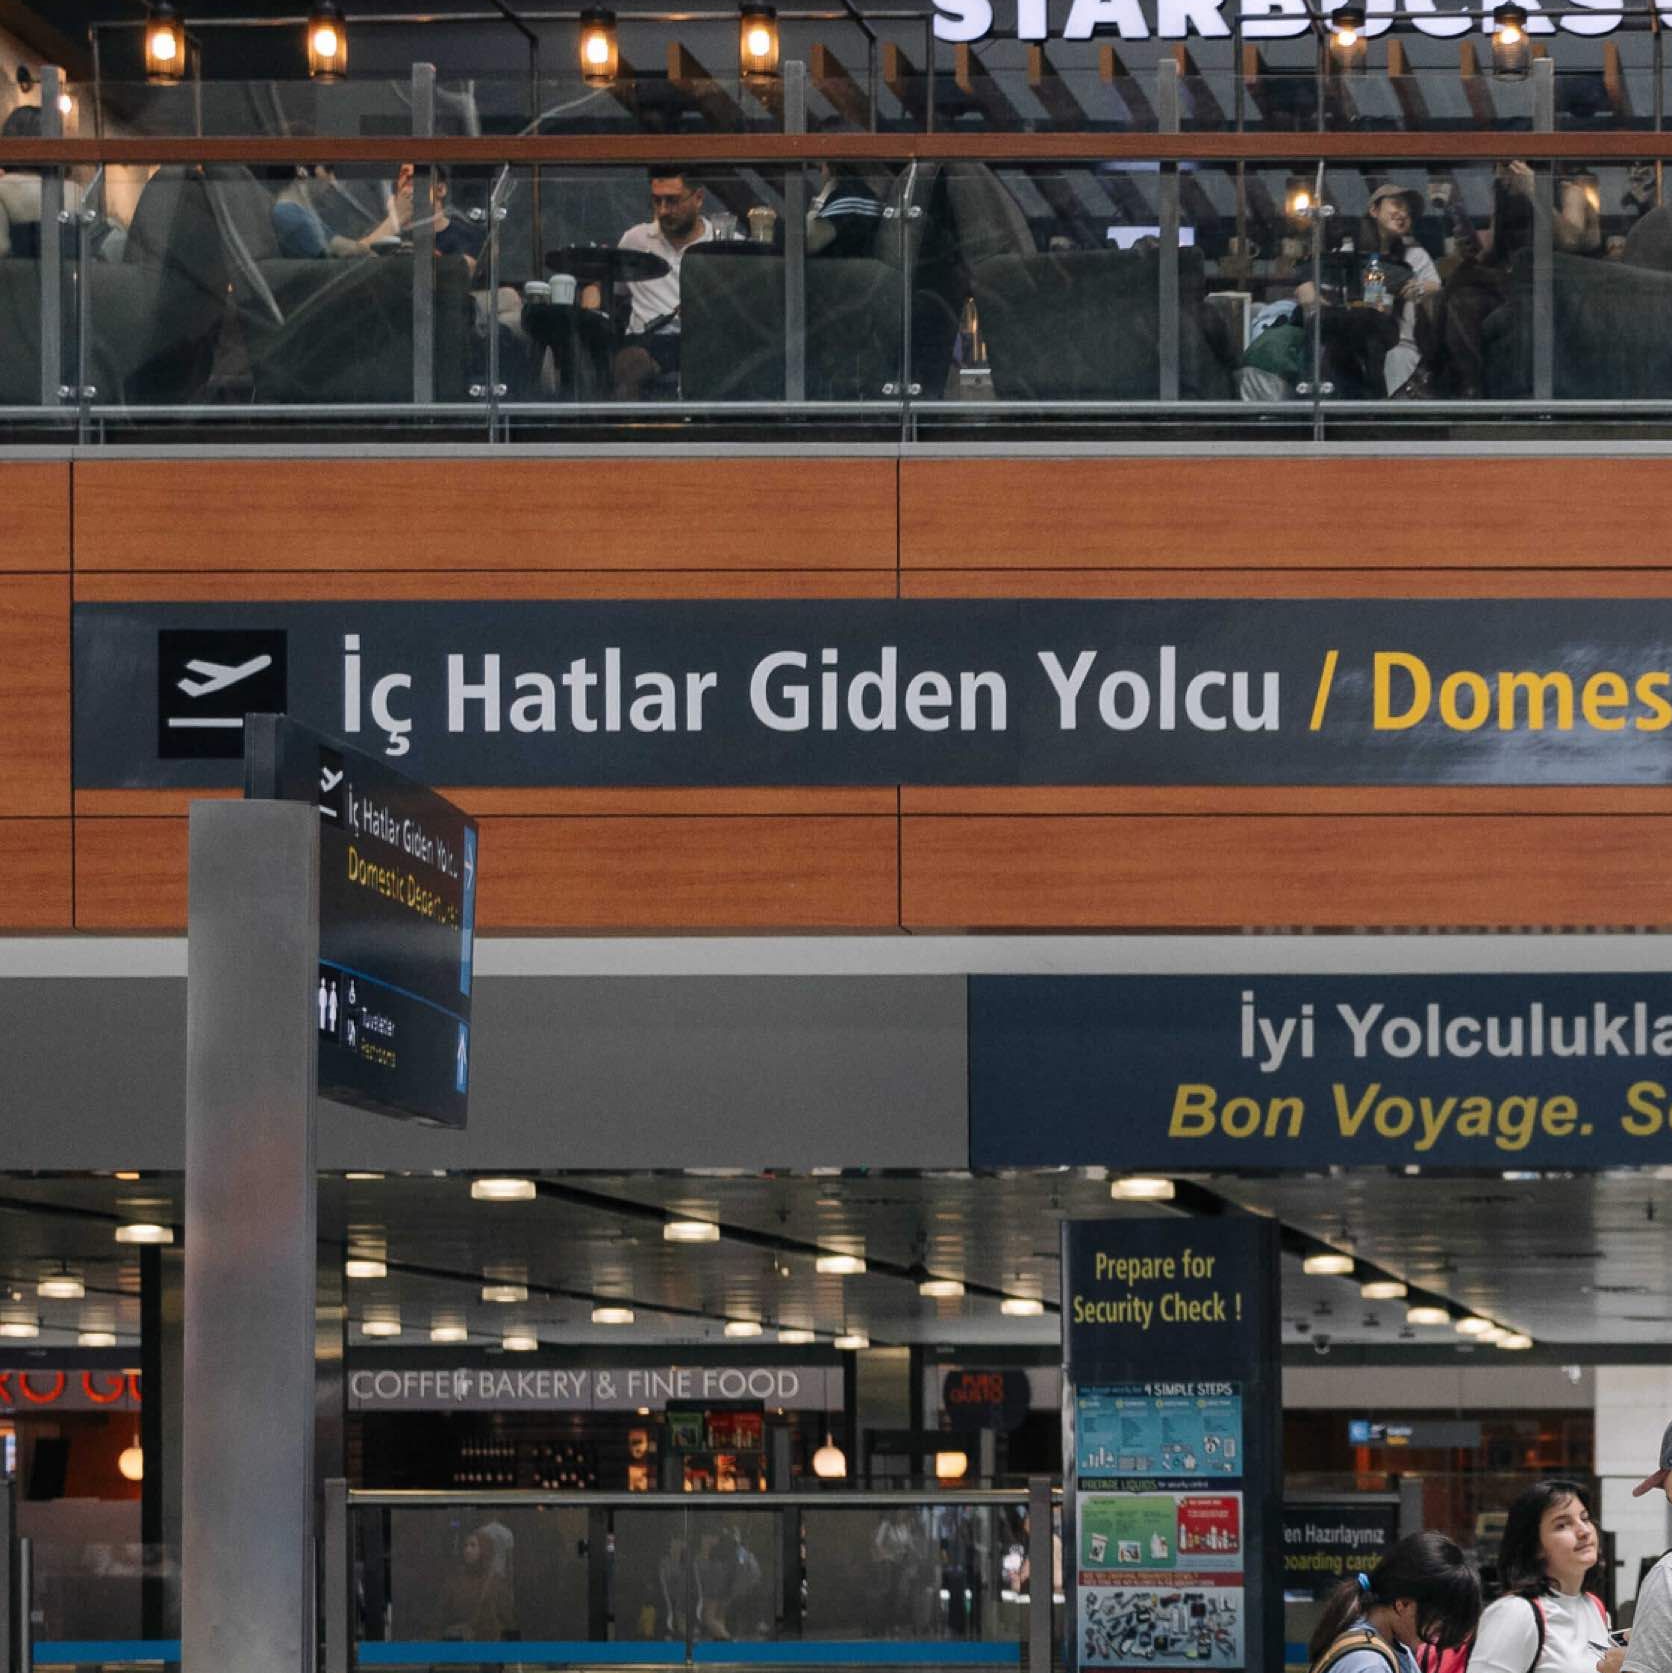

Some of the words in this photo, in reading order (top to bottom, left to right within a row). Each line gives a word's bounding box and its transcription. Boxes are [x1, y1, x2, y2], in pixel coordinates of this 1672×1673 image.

[341, 634, 413, 755] İç
[447, 647, 717, 733] Hatlar
[748, 646, 1007, 733] Giden
[1037, 645, 1280, 732] Yolcu
[363, 797, 400, 848] Hatlar
[403, 817, 434, 865] Giden
[347, 843, 405, 904] Domestic
[1242, 990, 1316, 1073] İyi
[1168, 1083, 1306, 1139] Bon
[1332, 1083, 1595, 1151] Voyage.
[1095, 1252, 1176, 1287] Prepare
[1182, 1248, 1216, 1279] for
[1073, 1293, 1154, 1330] Security
[1160, 1291, 1226, 1322] Check
[479, 1369, 588, 1400] BAKERY
[595, 1370, 618, 1400] &
[629, 1370, 691, 1400] FINE
[702, 1370, 799, 1400] FOOD
